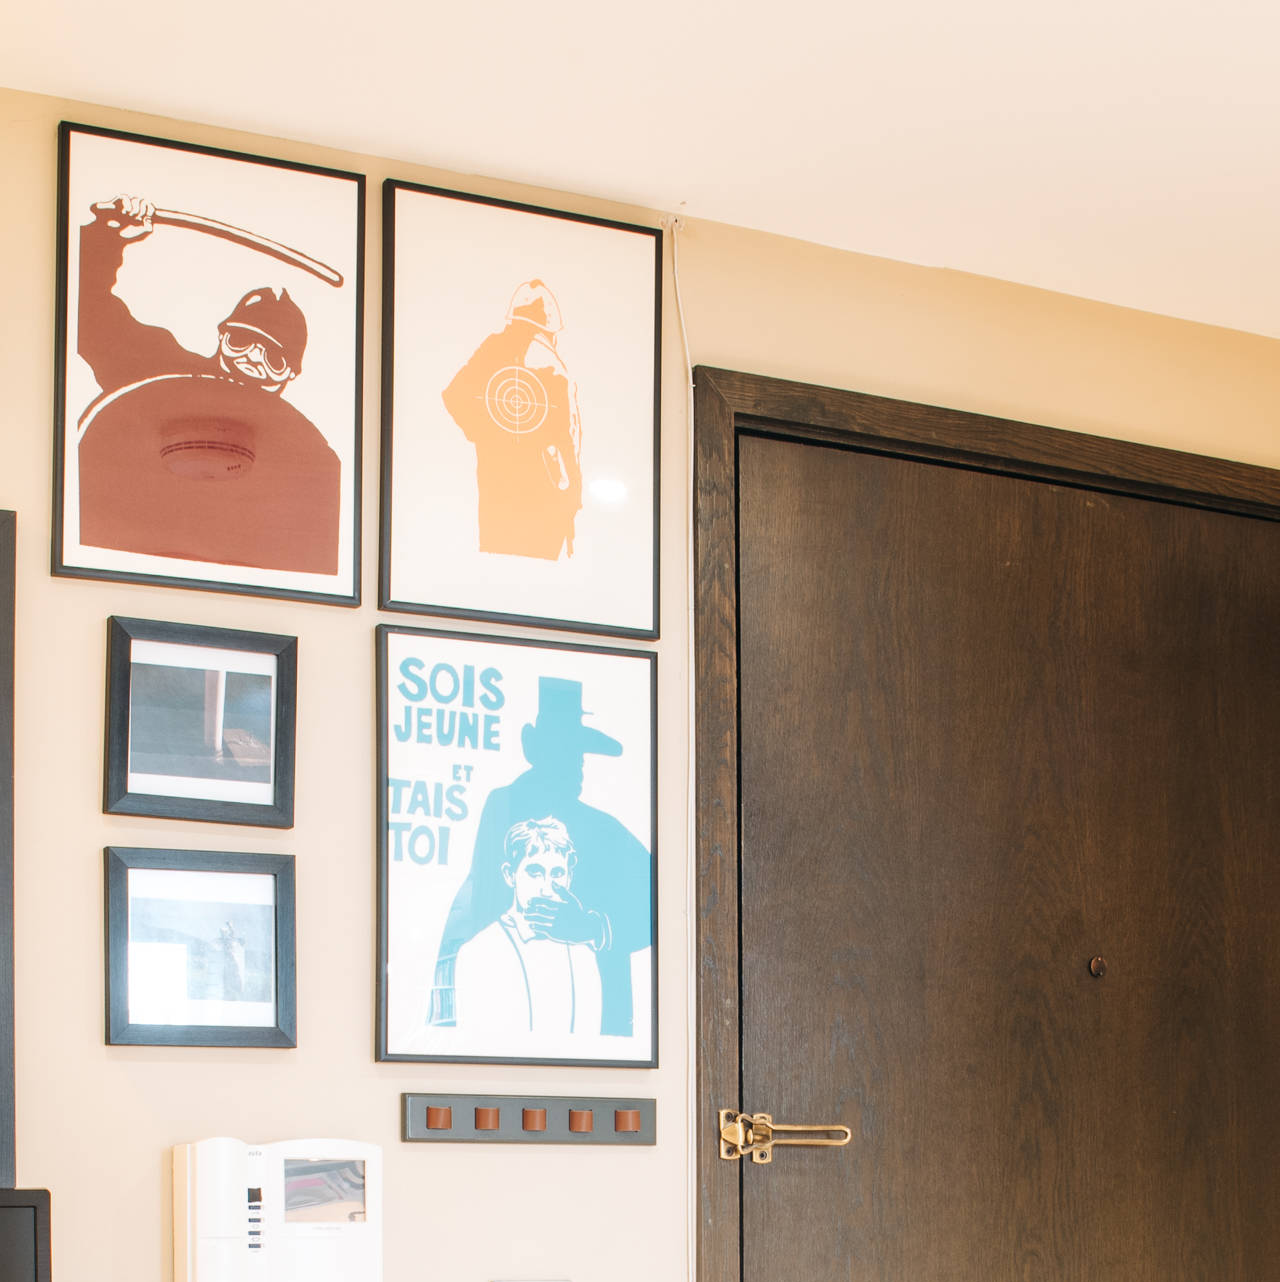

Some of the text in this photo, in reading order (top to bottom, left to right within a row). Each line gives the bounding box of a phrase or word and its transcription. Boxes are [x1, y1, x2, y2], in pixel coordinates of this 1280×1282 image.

[397, 656, 506, 711] SOIS
[393, 705, 501, 752] JEUNE
[452, 764, 474, 784] ET
[388, 777, 469, 822] TAIS
[388, 822, 451, 866] TOI
